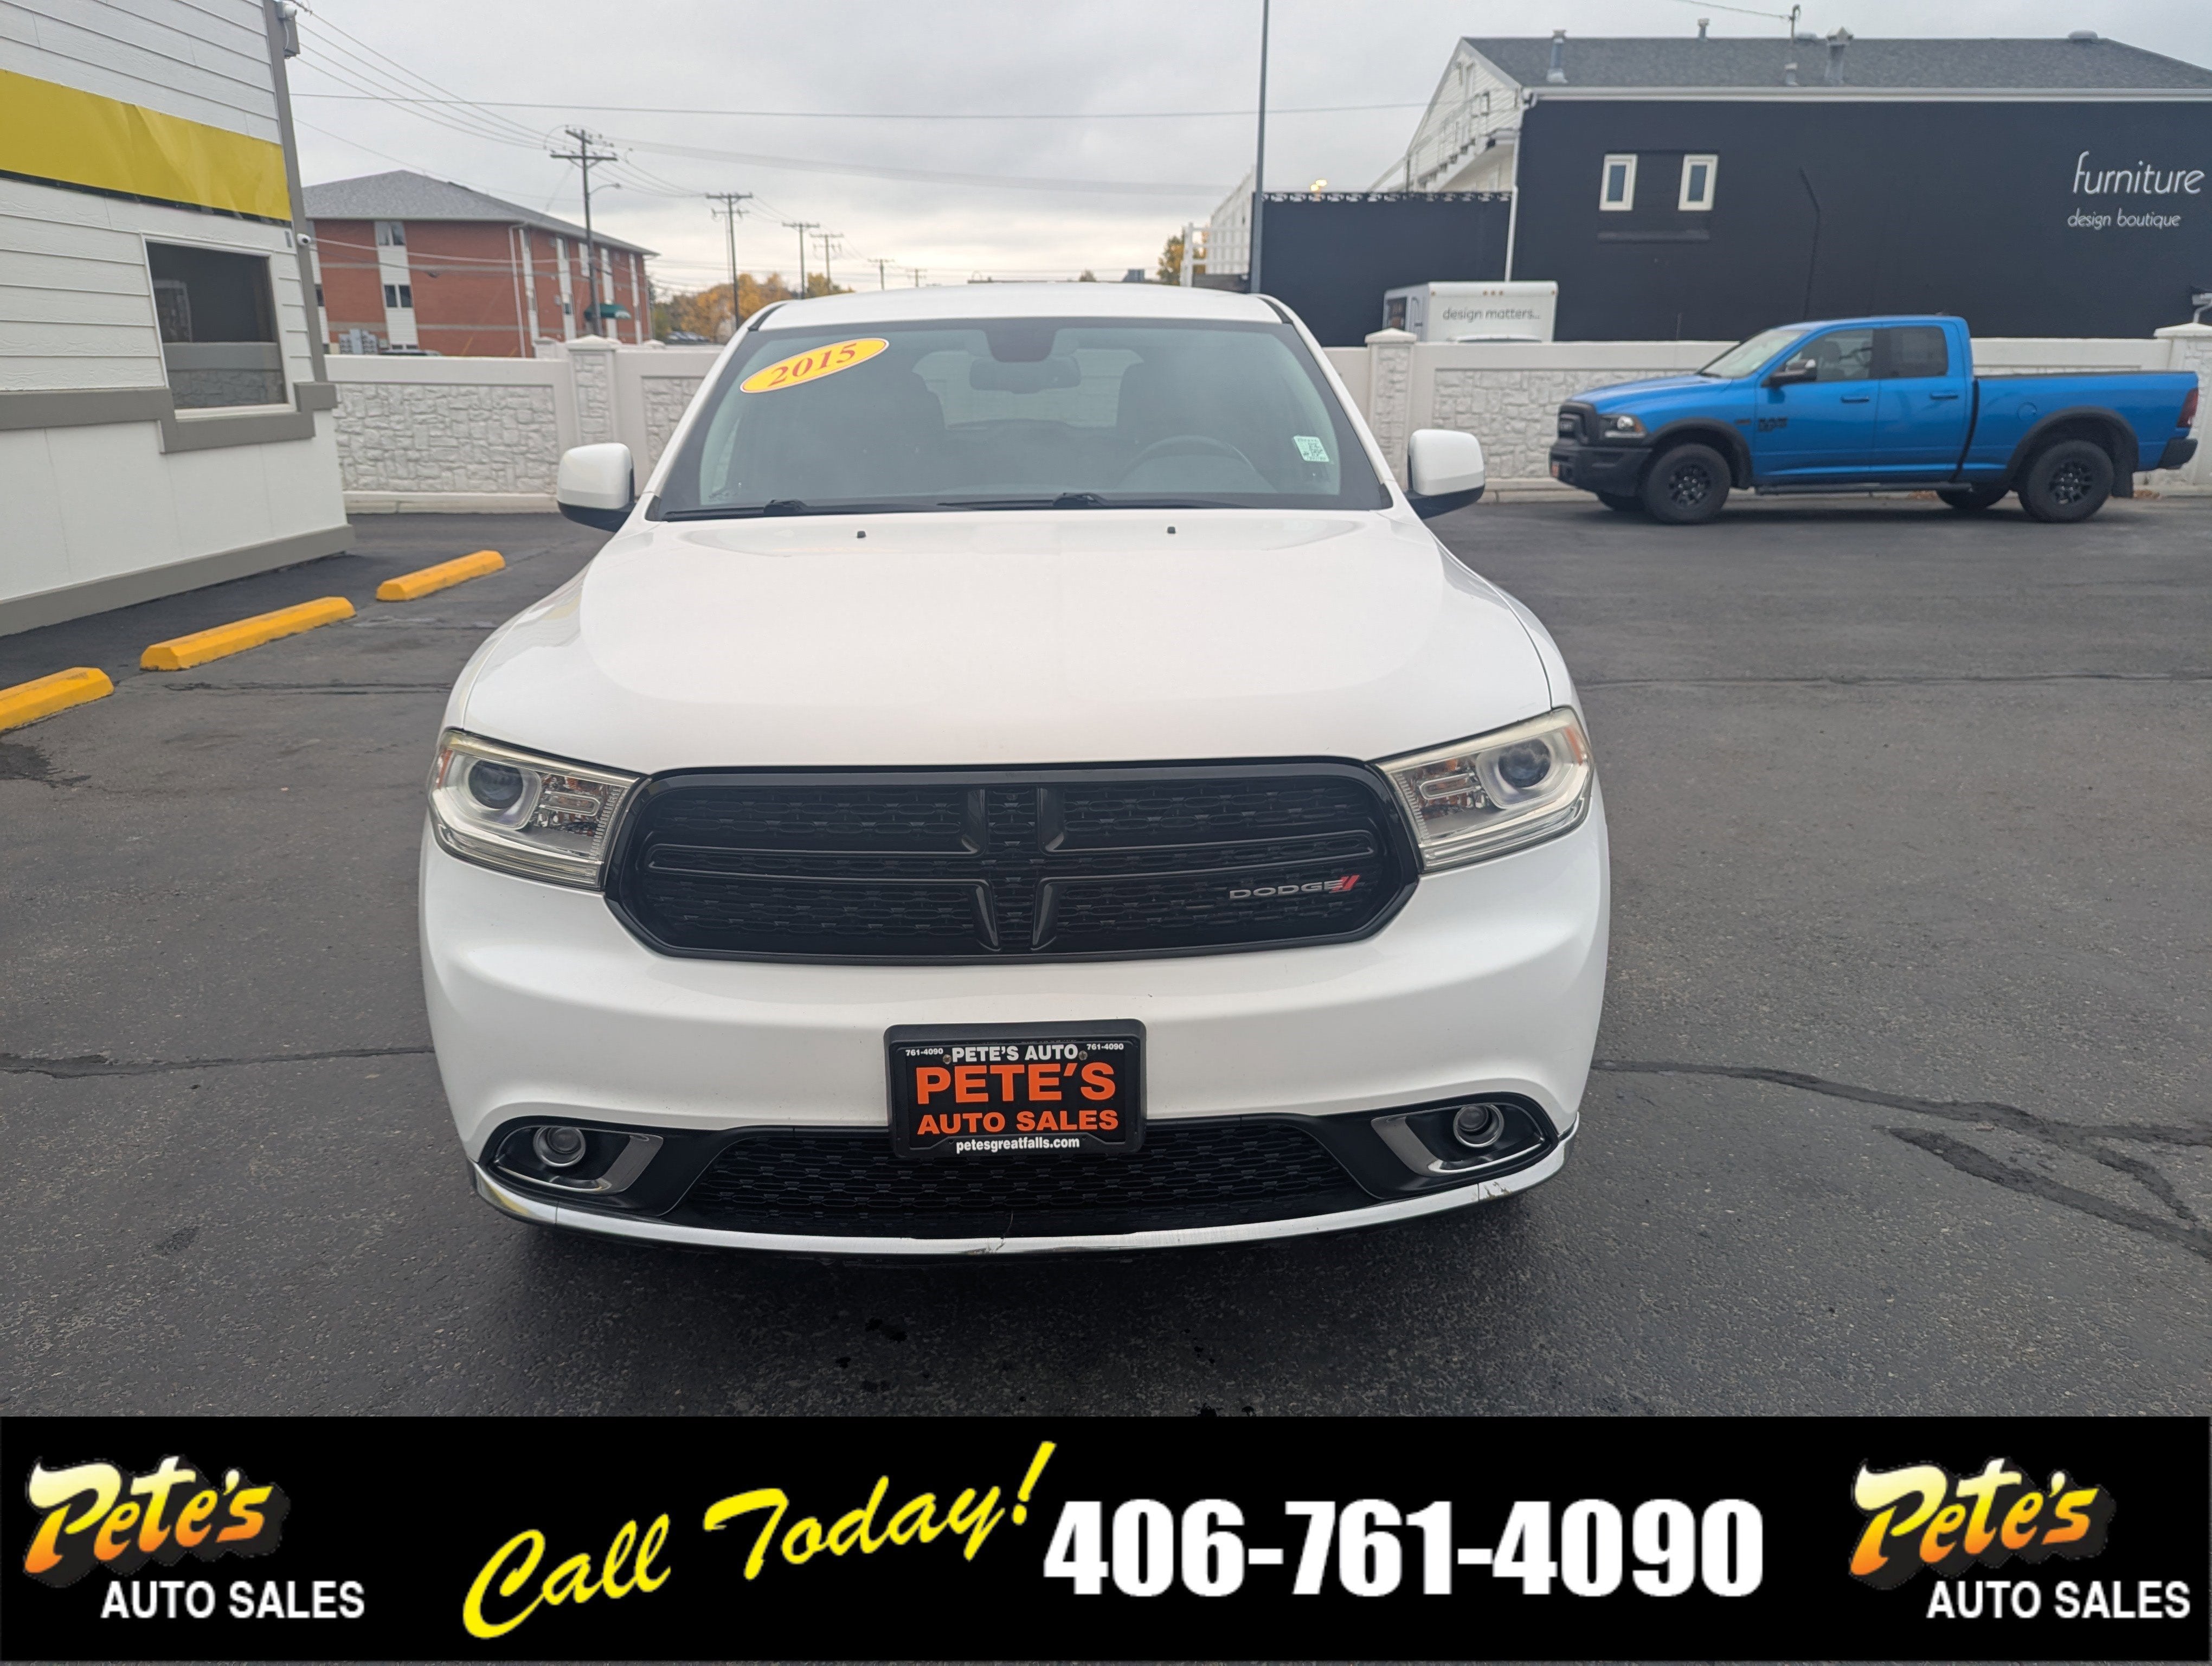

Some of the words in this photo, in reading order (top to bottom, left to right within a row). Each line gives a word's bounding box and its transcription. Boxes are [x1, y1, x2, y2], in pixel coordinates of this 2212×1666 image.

[2072, 150, 2205, 195] furniture
[2067, 207, 2112, 230] design
[2117, 207, 2182, 229] boutique
[1442, 307, 1482, 324] design
[767, 342, 858, 387] 2015
[1229, 879, 1344, 900] DODGE
[905, 1048, 944, 1056] 761-4090
[951, 1046, 1019, 1063] PETE'S
[1024, 1043, 1078, 1060] AUTO
[1086, 1042, 1124, 1051] 761-4090
[916, 1062, 1116, 1105] PETE'S
[917, 1112, 1006, 1135] AUTO
[1016, 1110, 1118, 1132] SALES
[956, 1137, 1080, 1154] petesgreatfalls.com
